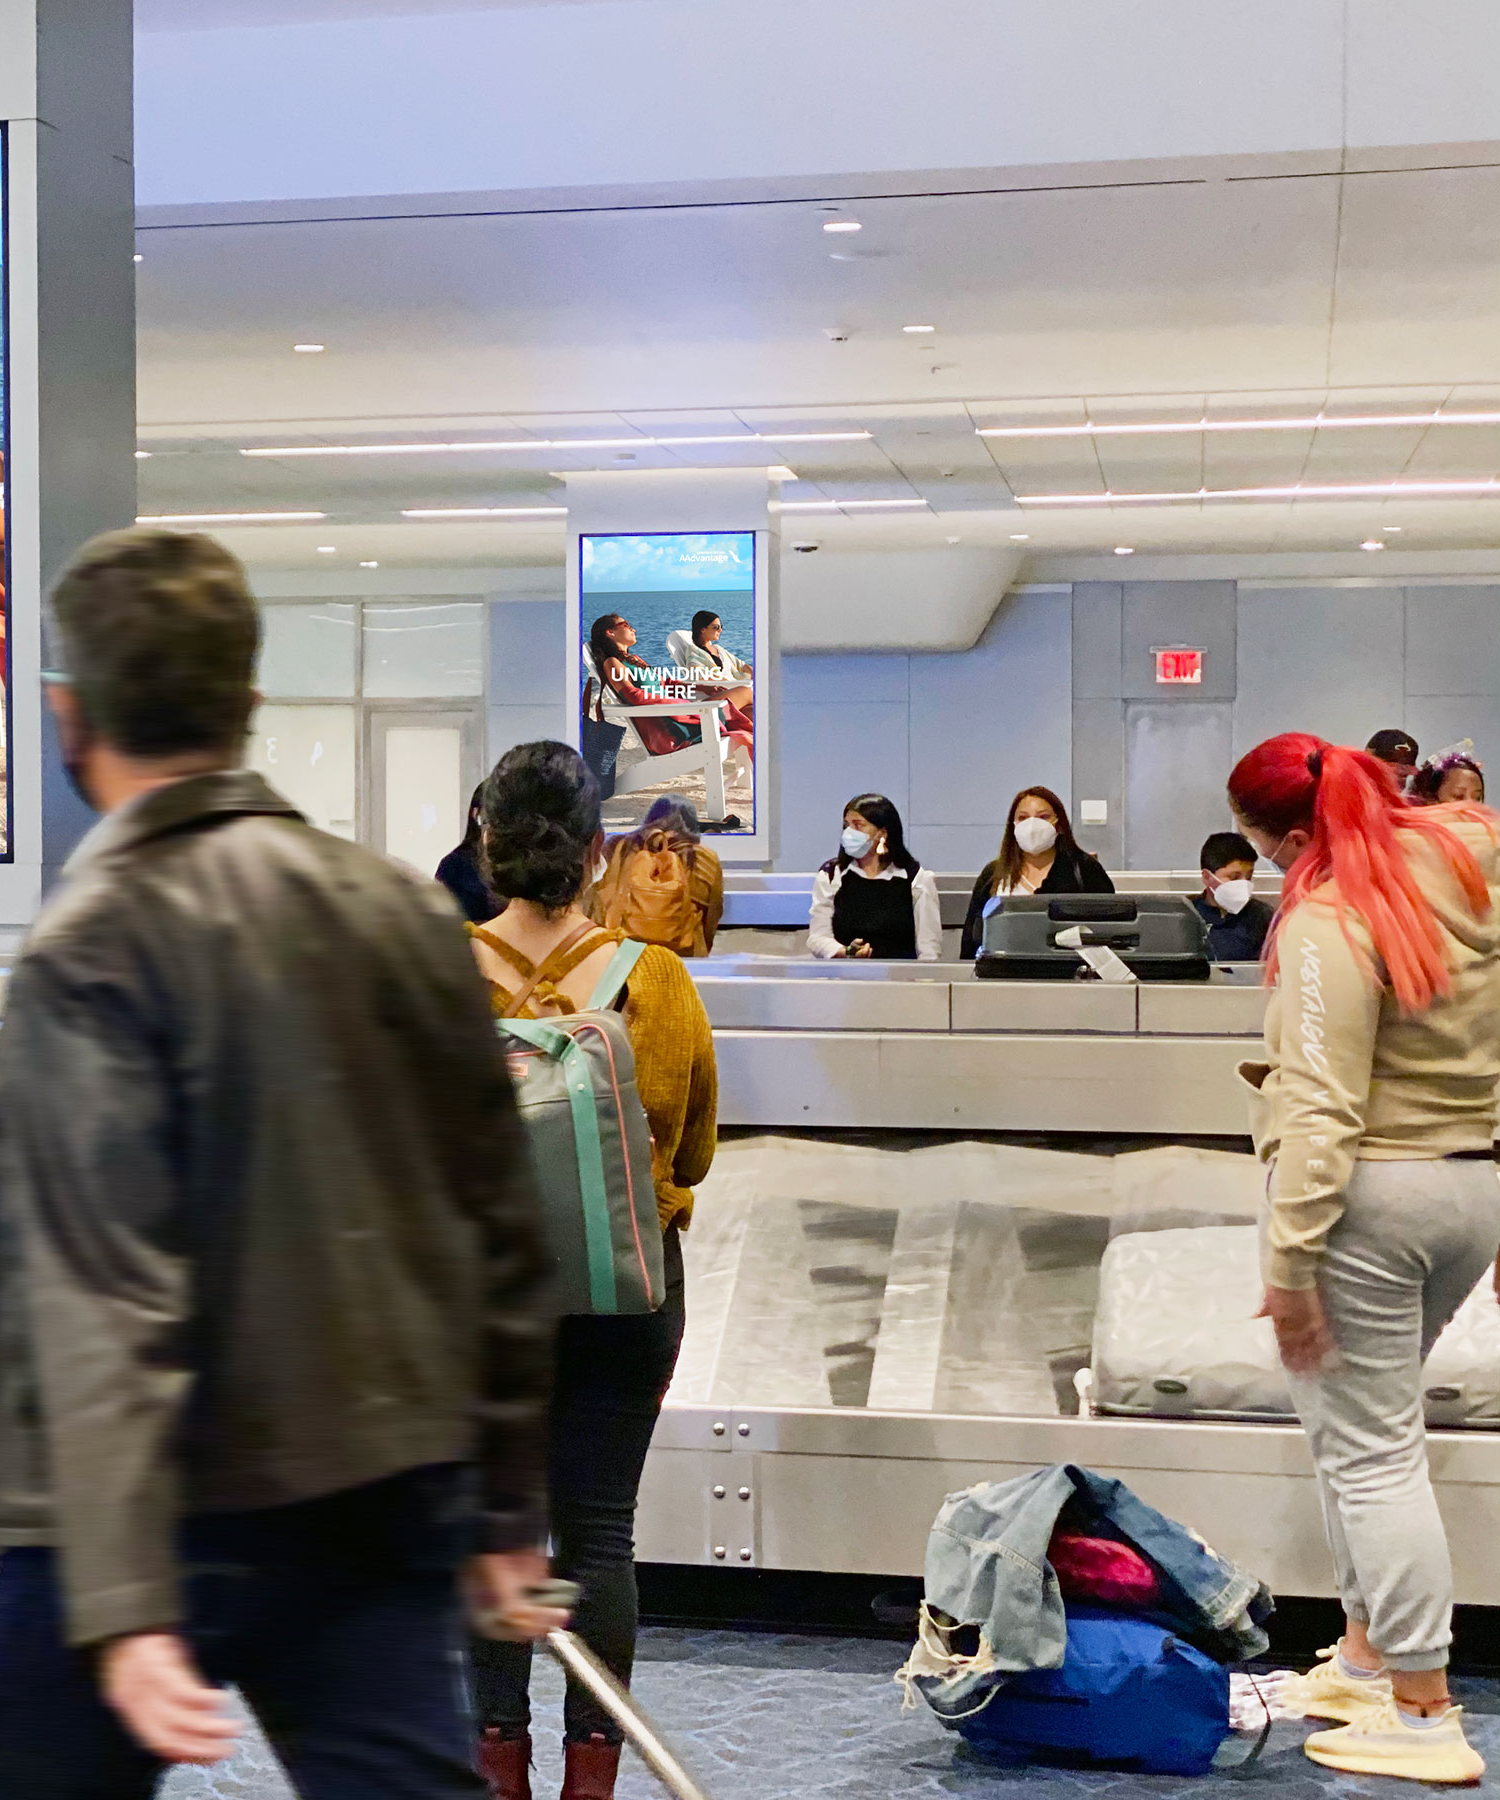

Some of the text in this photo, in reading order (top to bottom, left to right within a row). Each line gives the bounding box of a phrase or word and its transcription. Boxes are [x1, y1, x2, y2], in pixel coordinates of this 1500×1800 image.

[679, 554, 728, 564] AAdvantage
[1162, 652, 1198, 679] EXIT
[611, 666, 724, 682] UNWINDING
[640, 684, 697, 700] THERE
